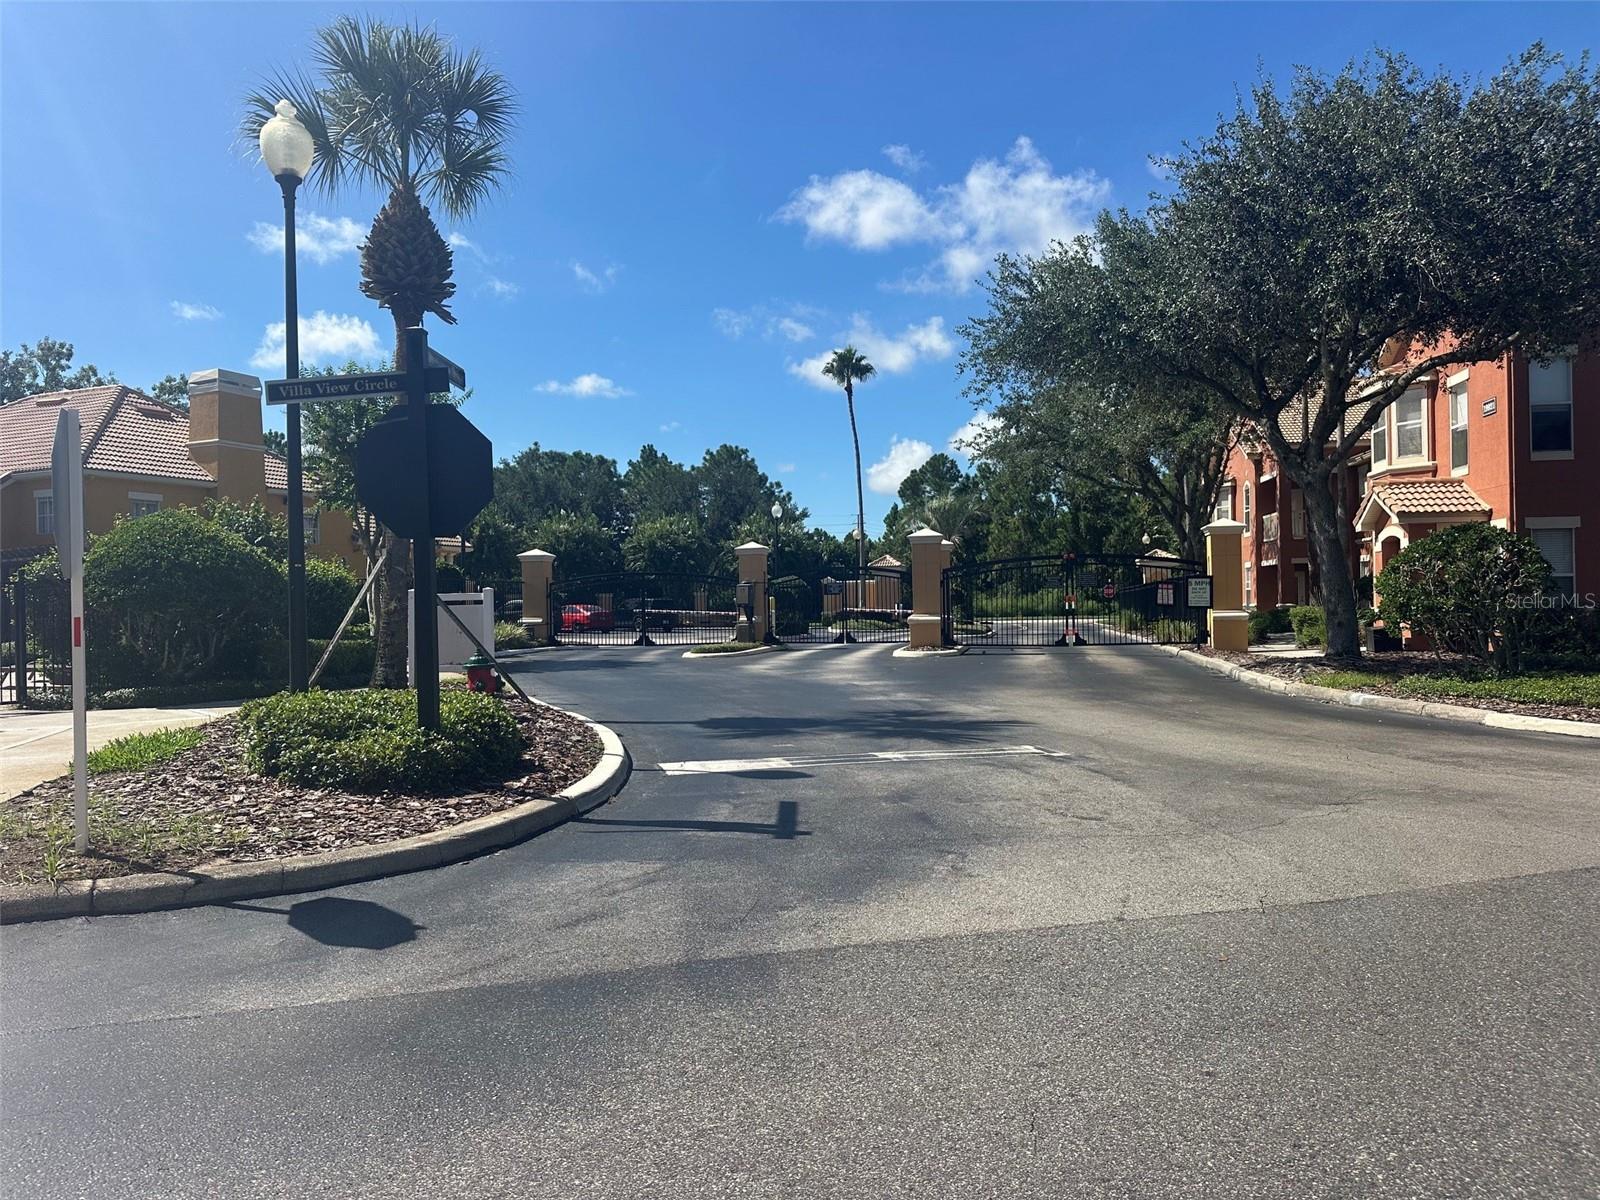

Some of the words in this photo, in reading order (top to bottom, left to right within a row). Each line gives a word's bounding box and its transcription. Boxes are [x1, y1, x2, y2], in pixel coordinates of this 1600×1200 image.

[279, 383, 312, 397] Villa
[316, 382, 349, 395] View
[354, 378, 398, 392] Circle
